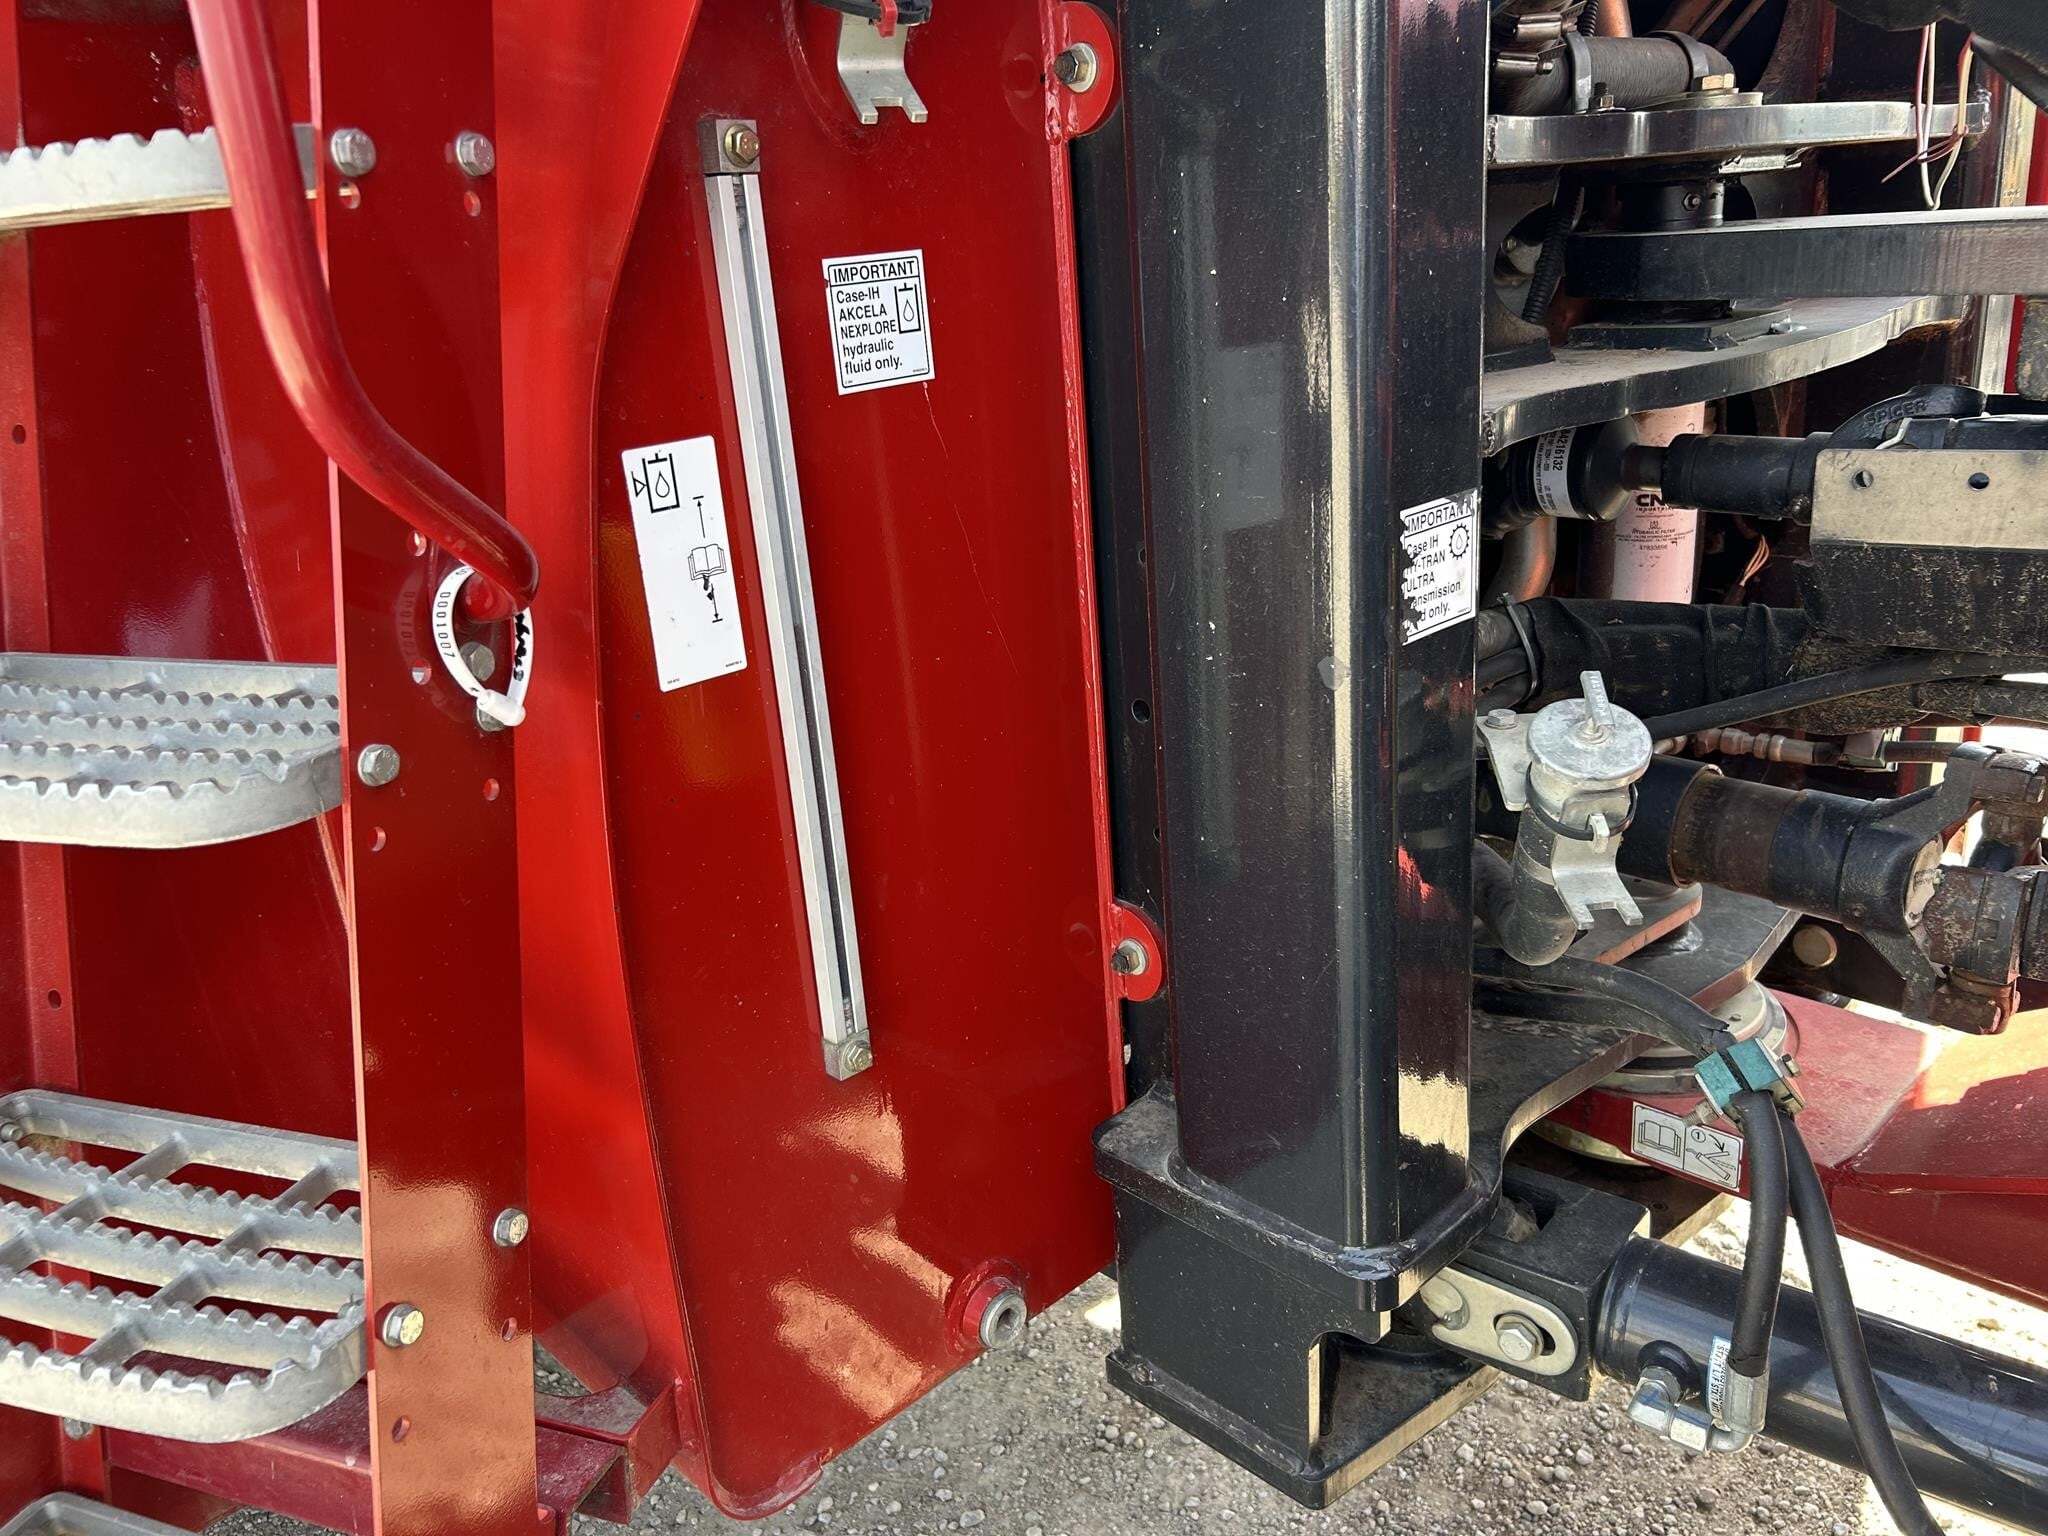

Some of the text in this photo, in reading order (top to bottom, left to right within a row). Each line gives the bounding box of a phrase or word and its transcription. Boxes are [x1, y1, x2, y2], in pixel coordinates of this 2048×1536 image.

[833, 260, 915, 283] IMPORTANT
[836, 286, 880, 304] Case-IH
[839, 303, 887, 322] AKCELA
[840, 319, 897, 340] NEXPLORE
[843, 338, 894, 360] hydraulic
[845, 354, 903, 375] fluid only.
[1429, 534, 1439, 548] IH
[1406, 571, 1435, 592] ULTRA
[1428, 600, 1451, 619] only.
[435, 591, 456, 658] 0001007
